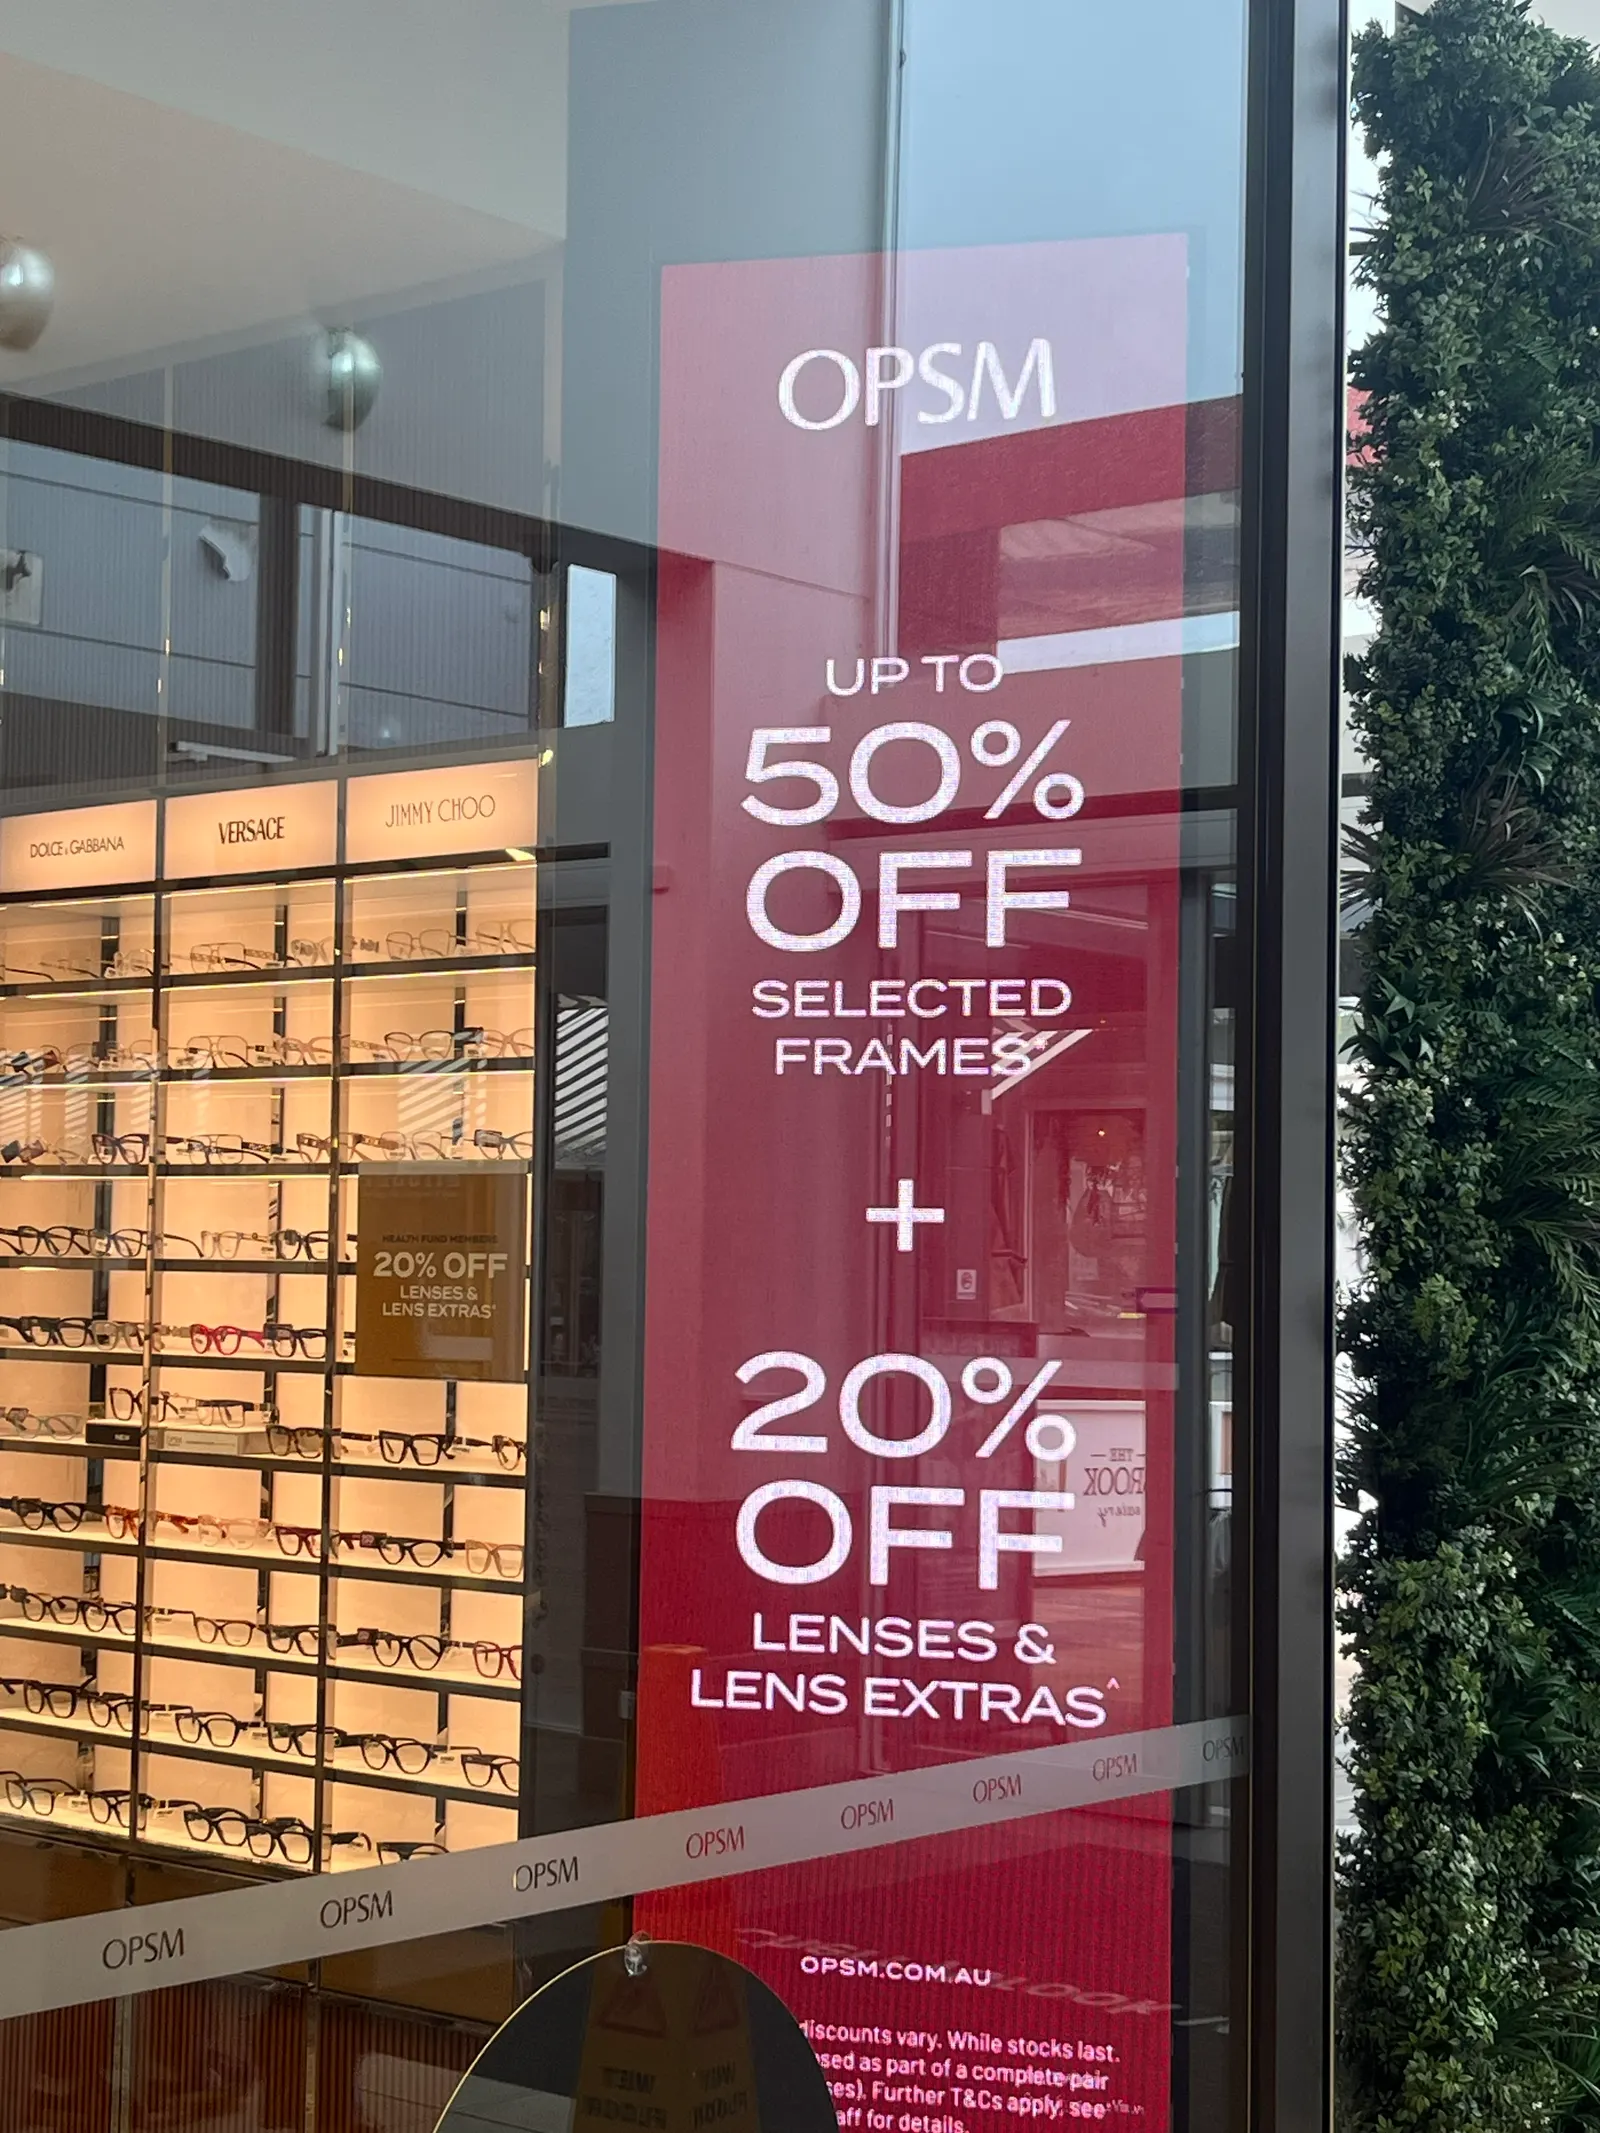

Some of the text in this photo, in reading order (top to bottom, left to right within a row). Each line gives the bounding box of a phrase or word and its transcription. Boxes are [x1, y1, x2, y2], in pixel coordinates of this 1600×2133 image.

[778, 338, 1057, 430] OPSM
[826, 653, 1004, 696] UP TO
[740, 719, 1085, 826] 50%
[385, 795, 496, 829] JIMMY CHOO
[218, 816, 286, 845] VERSACE
[745, 847, 1083, 952] OFF
[752, 979, 1072, 1019] SELECTED
[373, 1251, 508, 1280] 20% OFF
[382, 1302, 424, 1317] LENS
[400, 1285, 478, 1301] LENSES &
[730, 1350, 1077, 1461] 20%
[736, 1479, 1076, 1591] OFF
[753, 1612, 1057, 1665] LENSES &
[690, 1668, 848, 1714] LENS
[1202, 1736, 1245, 1763] OPSM
[1092, 1753, 1138, 1783] OPSM
[973, 1774, 1023, 1804] OPSM
[840, 1799, 895, 1831] OPSM
[686, 1825, 746, 1860] OPSM
[514, 1855, 580, 1893] OPSM
[319, 1889, 394, 1930] OPSM
[102, 1927, 186, 1971] OPSM
[800, 1954, 992, 1988] OPSM.COM.AU
[896, 2029, 943, 2053] vary.
[947, 2029, 1003, 2054] While
[1008, 2037, 1074, 2060] stocks
[1078, 2040, 1121, 2063] last.
[859, 2056, 882, 2073] as
[886, 2057, 927, 2078] part
[931, 2058, 952, 2078] of
[956, 2062, 969, 2080] a
[972, 2064, 1067, 2089] complete
[1069, 2069, 1109, 2092] pair
[872, 2080, 946, 2107] Further
[951, 2086, 1003, 2111] T&Cs
[1069, 2101, 1106, 2119] see
[867, 2107, 895, 2131] for
